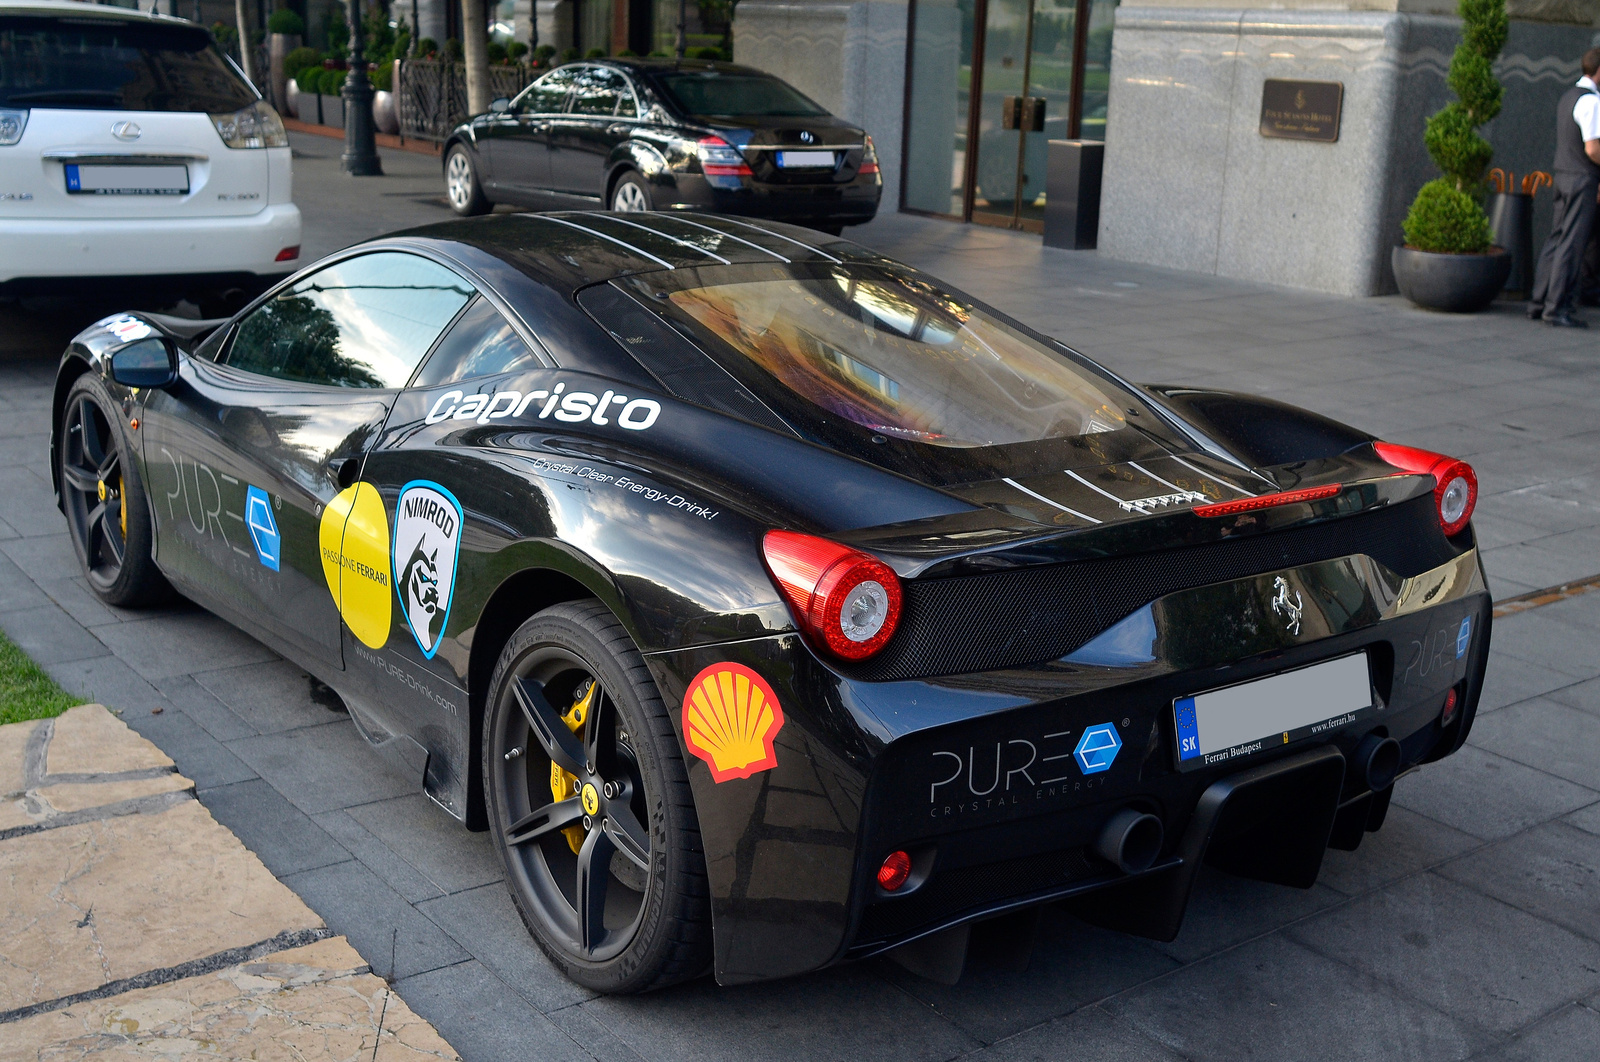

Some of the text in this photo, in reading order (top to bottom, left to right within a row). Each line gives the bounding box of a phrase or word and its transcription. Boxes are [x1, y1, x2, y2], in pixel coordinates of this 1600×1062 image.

[424, 382, 662, 431] Capristo
[161, 447, 250, 558] PURE
[533, 457, 720, 521] Crystal Clear Energy-Drink!
[404, 497, 455, 539] NIMROD
[322, 547, 388, 587] PASSIONE FERRARI
[1403, 622, 1459, 685] PURE
[354, 645, 457, 716] www.PURE-Drink.com
[1182, 736, 1197, 752] SK
[1311, 713, 1356, 734] www.ferrari.hu
[930, 730, 1071, 803] PURE
[1204, 741, 1262, 765] Ferrari Budapest
[930, 776, 1106, 818] CRYSTAL ENERGY
